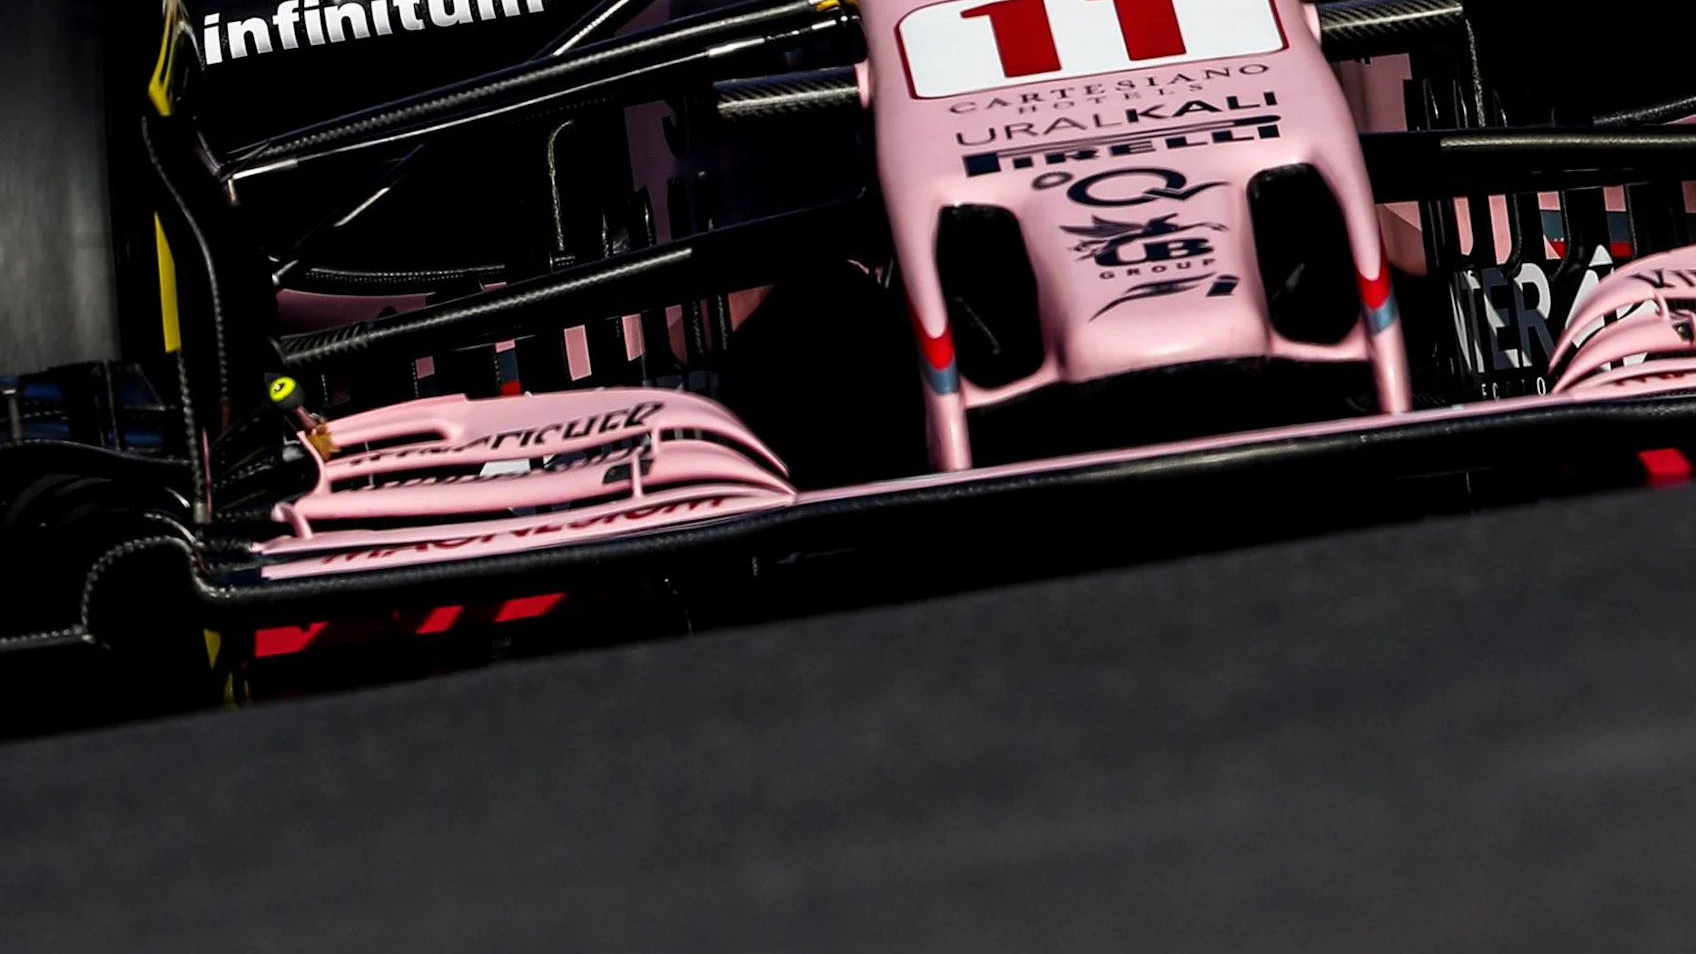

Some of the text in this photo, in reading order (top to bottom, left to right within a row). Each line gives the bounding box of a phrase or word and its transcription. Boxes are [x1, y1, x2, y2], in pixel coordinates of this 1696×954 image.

[949, 63, 1270, 115] CARTESIANO
[1018, 84, 1205, 115] HOTELS
[955, 91, 1279, 146] URALKALI
[962, 114, 1282, 178] PIRELLI
[1098, 257, 1216, 281] GROUP
